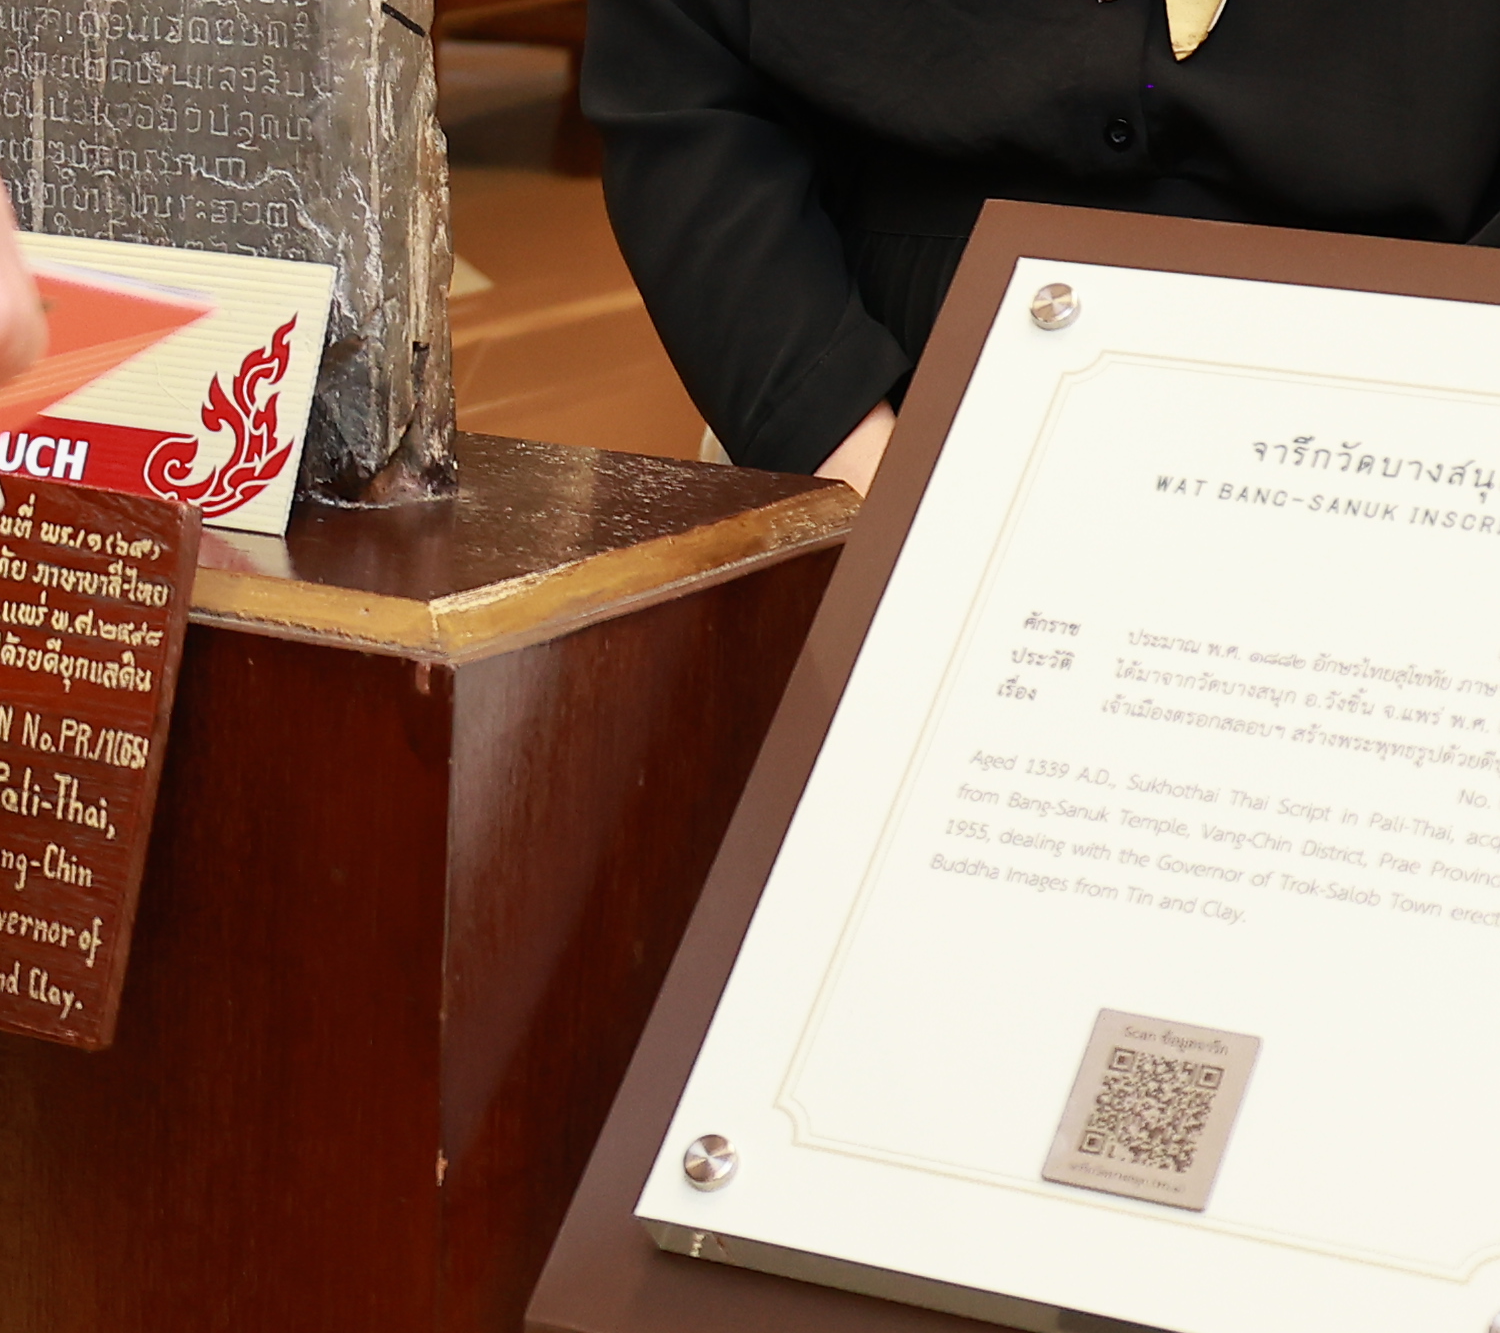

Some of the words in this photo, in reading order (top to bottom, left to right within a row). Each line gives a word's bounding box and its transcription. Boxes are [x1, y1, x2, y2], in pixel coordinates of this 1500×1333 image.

[1155, 474, 1208, 497] WAT
[1218, 482, 1400, 523] BANG-SANUK
[1023, 611, 1081, 637] ศักราช
[1011, 646, 1076, 672] ประวัติ
[1115, 657, 1298, 709] ได้มาจากวัดบางสนุก
[1128, 628, 1201, 655] ประมาณ
[1207, 641, 1241, 661] พ.ศ.
[1313, 652, 1452, 690] อักษรไทยสุโขทัย
[996, 674, 1038, 702] เรื่อง
[970, 749, 1019, 772] Aged
[1025, 758, 1071, 779] 1339
[1126, 773, 1222, 804] Sukhothai
[1230, 788, 1269, 812] Thai
[1277, 797, 1333, 824] Script
[1341, 808, 1359, 826] in
[1368, 812, 1455, 845] Pali-Thai,
[1458, 788, 1492, 810] No.
[956, 783, 1000, 806] from
[1007, 791, 1110, 823] Bang-Sanuk
[1119, 808, 1191, 839] Temple,
[1200, 822, 1293, 853] Vang-Chin
[1301, 838, 1368, 869] District,
[1379, 851, 1422, 876] Prae
[929, 853, 1001, 881] Buddha
[1005, 866, 1069, 893] Images
[1074, 877, 1119, 901] from
[1125, 885, 1154, 907] Tin
[1158, 896, 1199, 915] and
[1201, 899, 1247, 927] Clay.
[944, 819, 992, 843] 1955,
[999, 827, 1067, 858] dealing
[1071, 840, 1112, 862] with
[1117, 848, 1151, 868] the
[1156, 853, 1246, 884] Governor
[1249, 870, 1275, 888] of
[1280, 871, 1382, 908] Trok-Salob
[1390, 891, 1444, 917] Town
[77, 915, 103, 968] of
[28, 966, 84, 1021] Clay.
